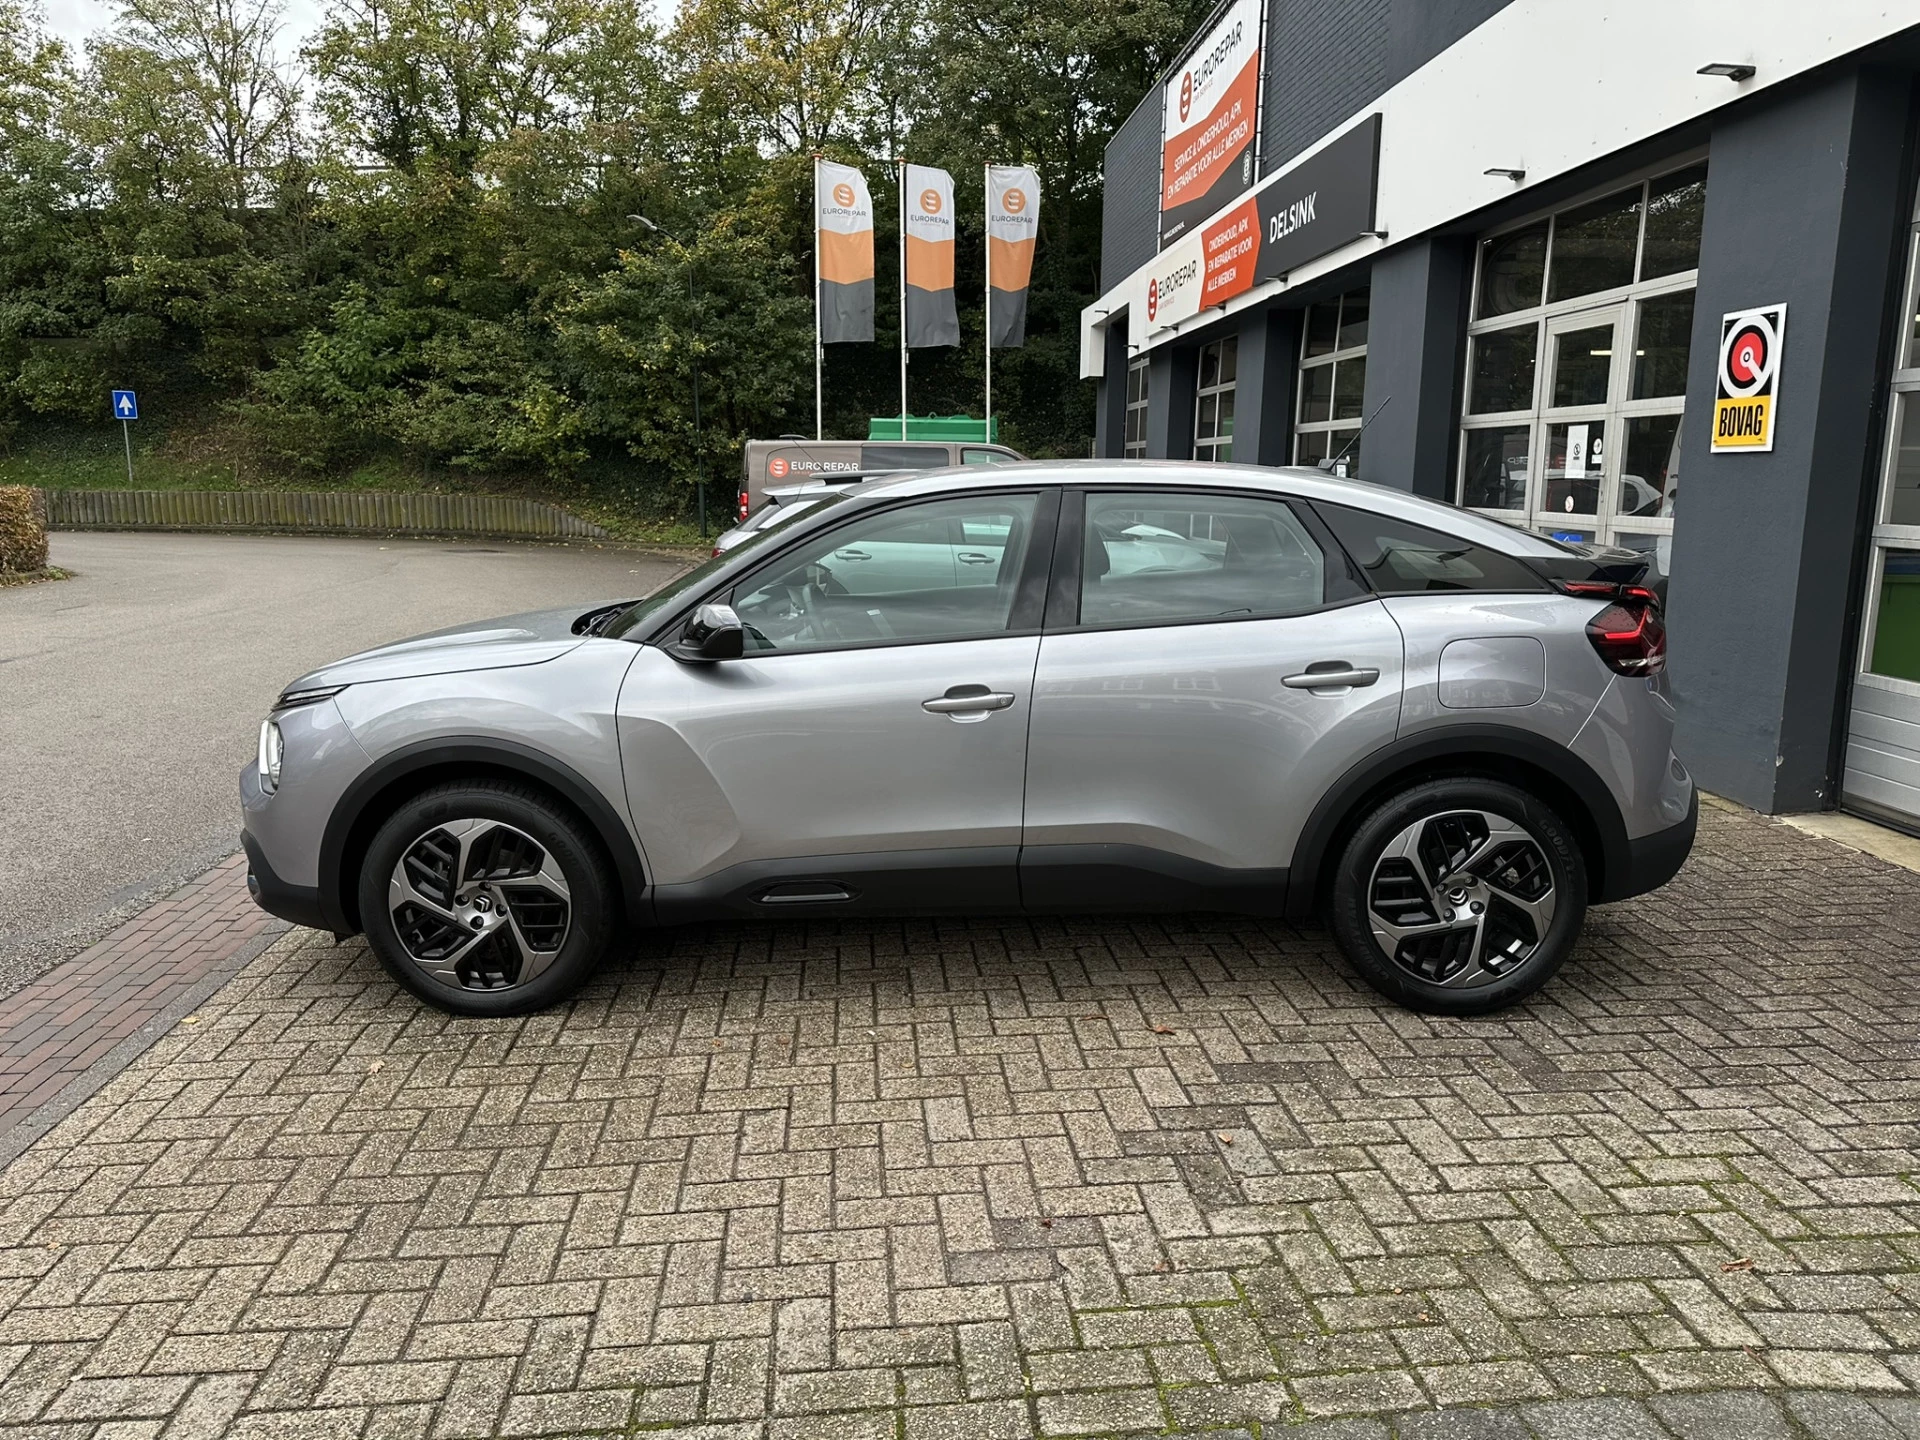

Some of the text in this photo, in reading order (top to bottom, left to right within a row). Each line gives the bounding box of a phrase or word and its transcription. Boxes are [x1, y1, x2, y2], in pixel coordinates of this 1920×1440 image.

[1194, 20, 1242, 91] EUROREPAR
[1174, 145, 1193, 172] SERVICE
[1229, 98, 1242, 122] APK
[1167, 183, 1174, 199] EN
[1197, 151, 1213, 175] VOOR
[1211, 138, 1225, 162] ALLE
[822, 207, 867, 217] EUROREPAR
[910, 214, 950, 225] EUROREPAR
[991, 214, 1033, 224] EUROREPAR
[1238, 216, 1249, 234] APK
[1269, 191, 1317, 244] DELSINK
[1238, 236, 1253, 256] VOOR
[1158, 259, 1196, 299] EUROREPAR
[1718, 404, 1764, 437] BOVAG
